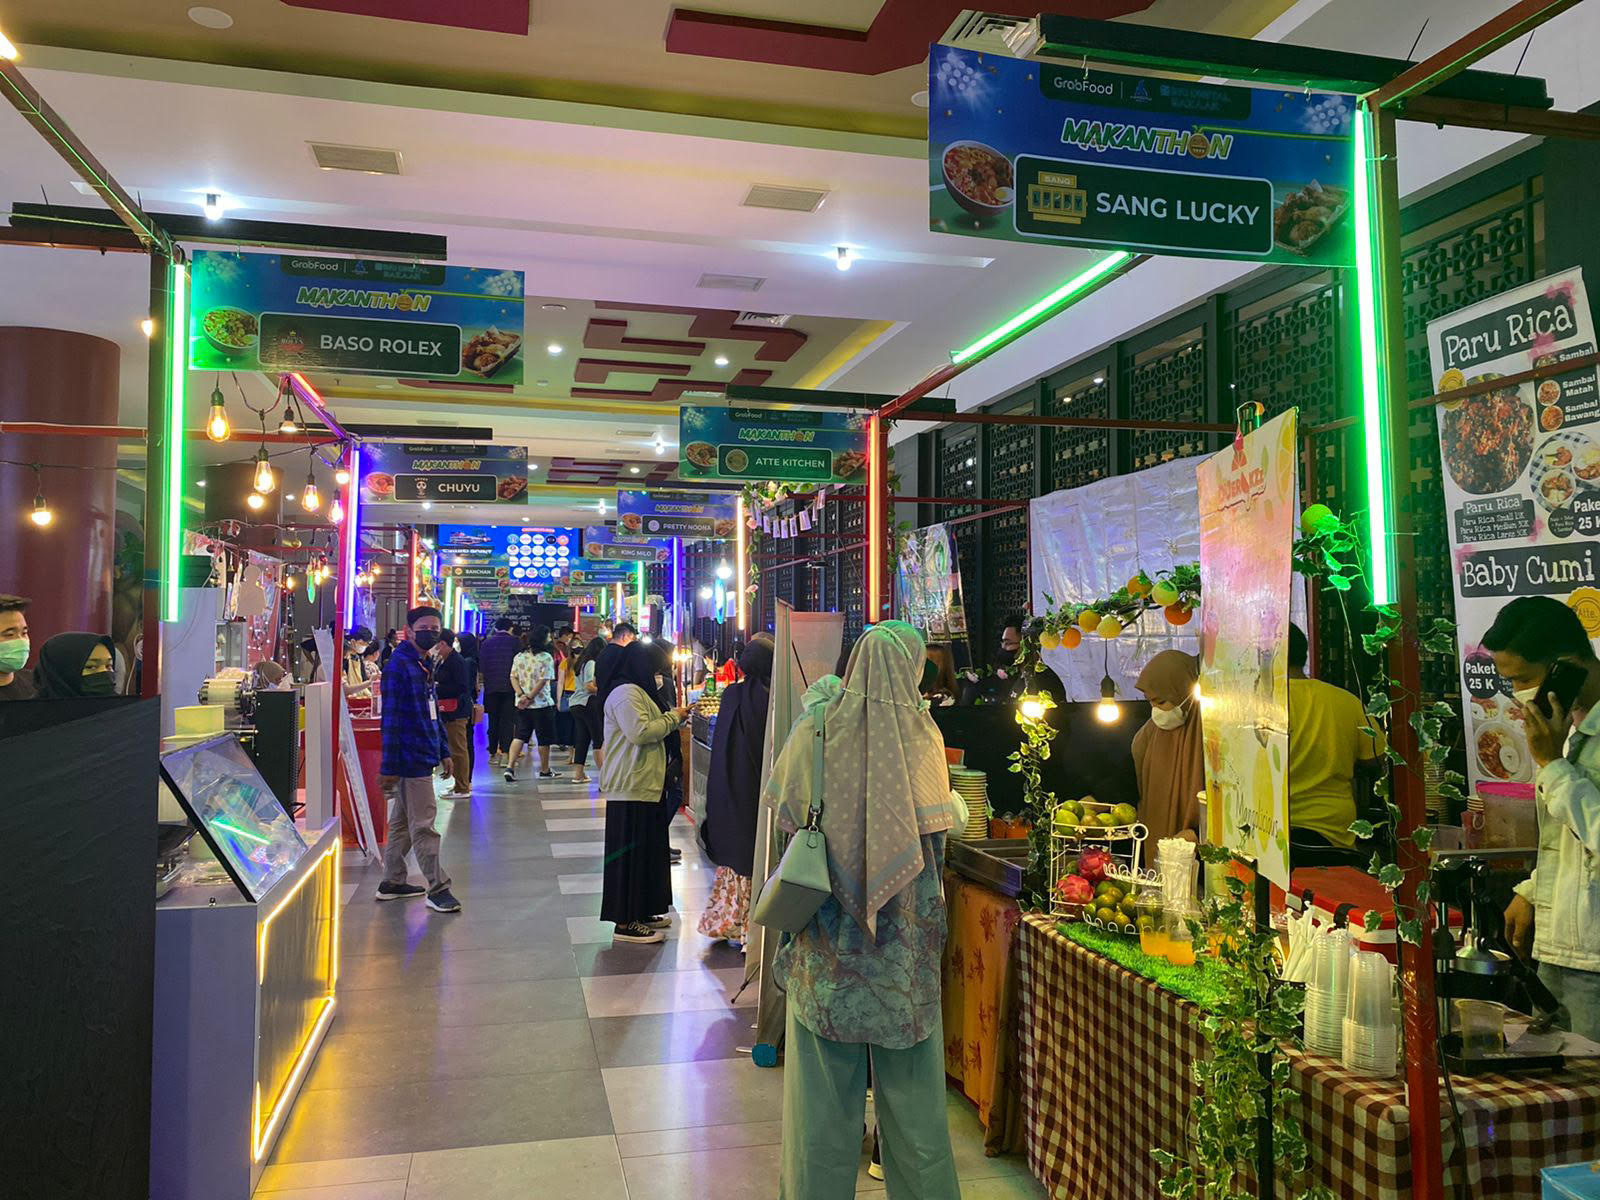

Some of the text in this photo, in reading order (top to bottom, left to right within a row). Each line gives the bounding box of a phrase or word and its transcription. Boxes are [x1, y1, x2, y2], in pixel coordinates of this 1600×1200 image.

[1054, 77, 1113, 95] GrabFood
[1061, 117, 1233, 160] MAKANTHON
[1096, 192, 1260, 225] SANG LUCKY
[291, 260, 339, 271] GrabFood
[296, 286, 431, 312] MAKANTHON
[1445, 304, 1573, 366] Paru Rica
[320, 334, 442, 356] BASO ROLEX
[1559, 346, 1593, 361] Sambal
[1562, 374, 1595, 388] Sambal
[1566, 385, 1594, 397] Matah
[1565, 400, 1598, 413] Sambal
[755, 457, 825, 468] ATTE KITCHEN
[438, 483, 480, 493] CHUYU
[1465, 497, 1520, 514] Paru Rica
[1578, 516, 1592, 529] 25
[1462, 549, 1595, 592] Baby Cumi
[1465, 662, 1496, 675] Paket
[1469, 678, 1482, 689] 25
[1485, 678, 1495, 690] K
